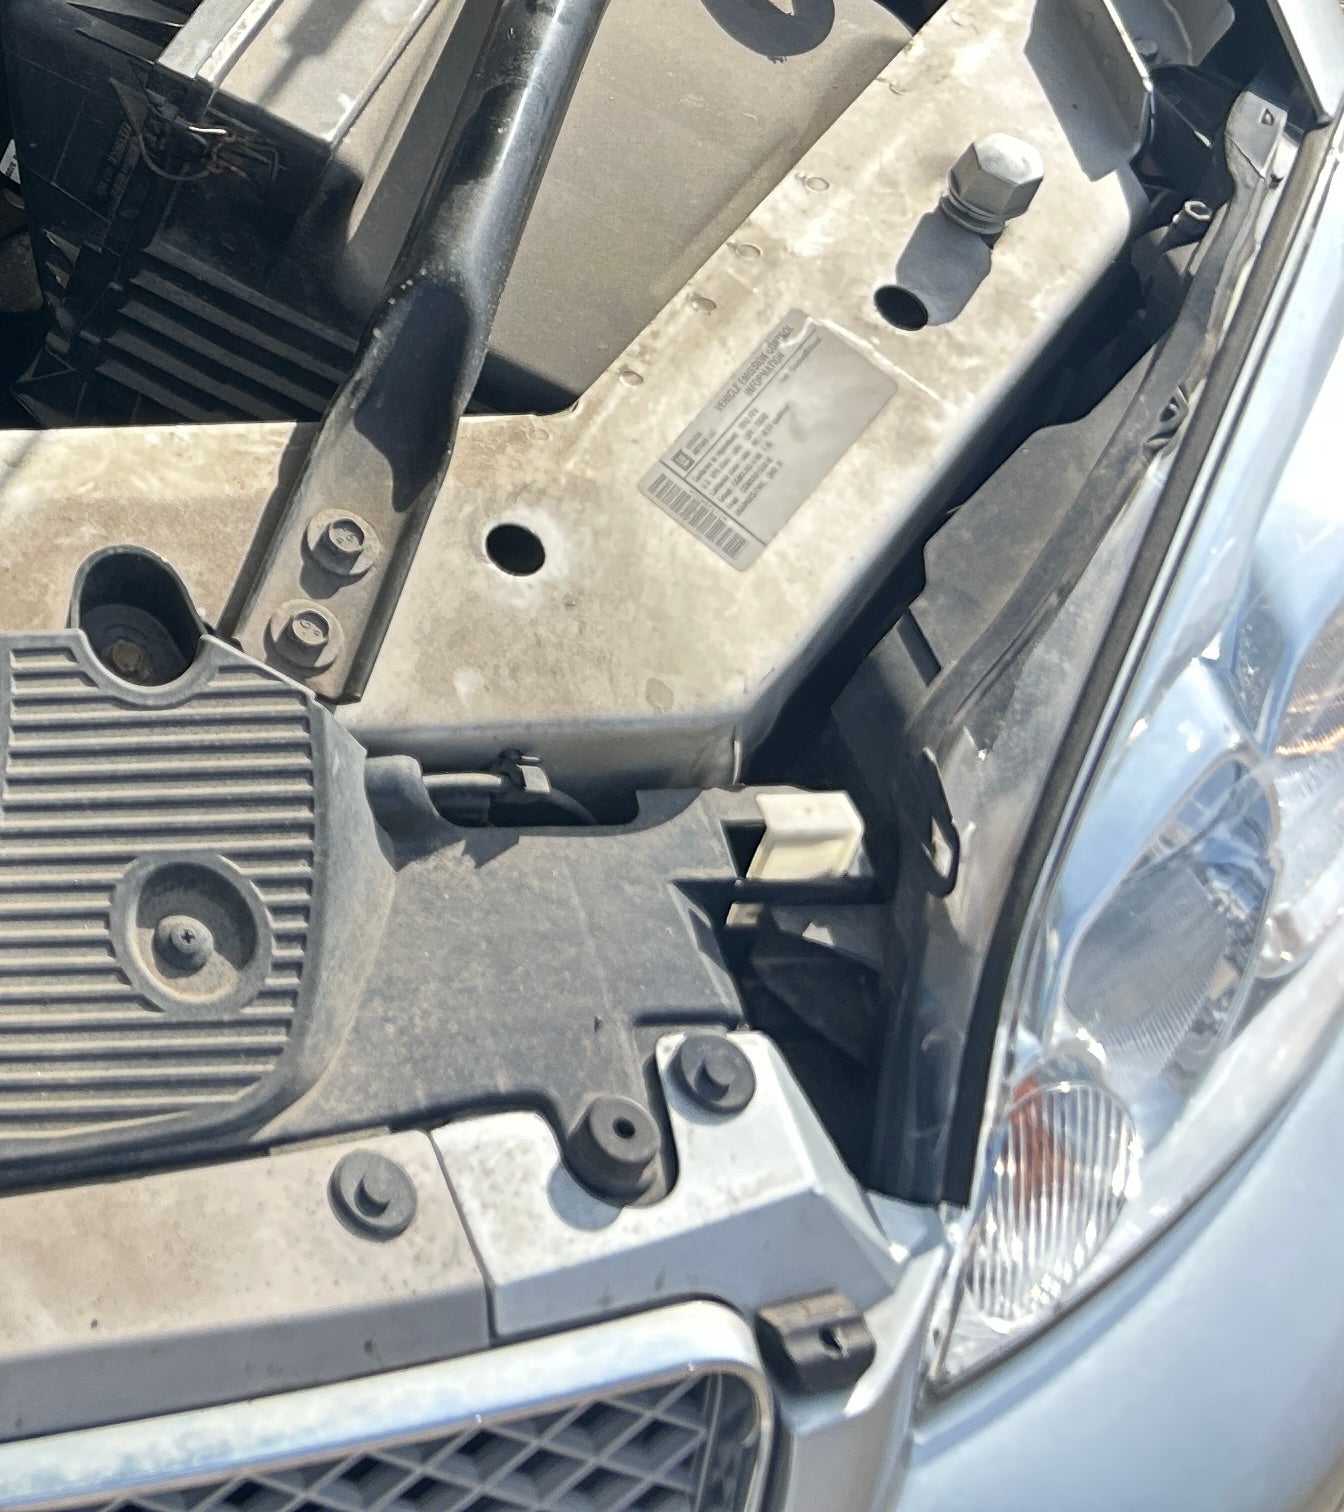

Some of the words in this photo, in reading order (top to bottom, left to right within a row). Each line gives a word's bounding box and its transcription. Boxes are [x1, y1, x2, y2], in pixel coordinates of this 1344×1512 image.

[713, 381, 742, 413] VEHICLE
[737, 351, 769, 386] EMISSION
[742, 350, 786, 397] INFORMATION
